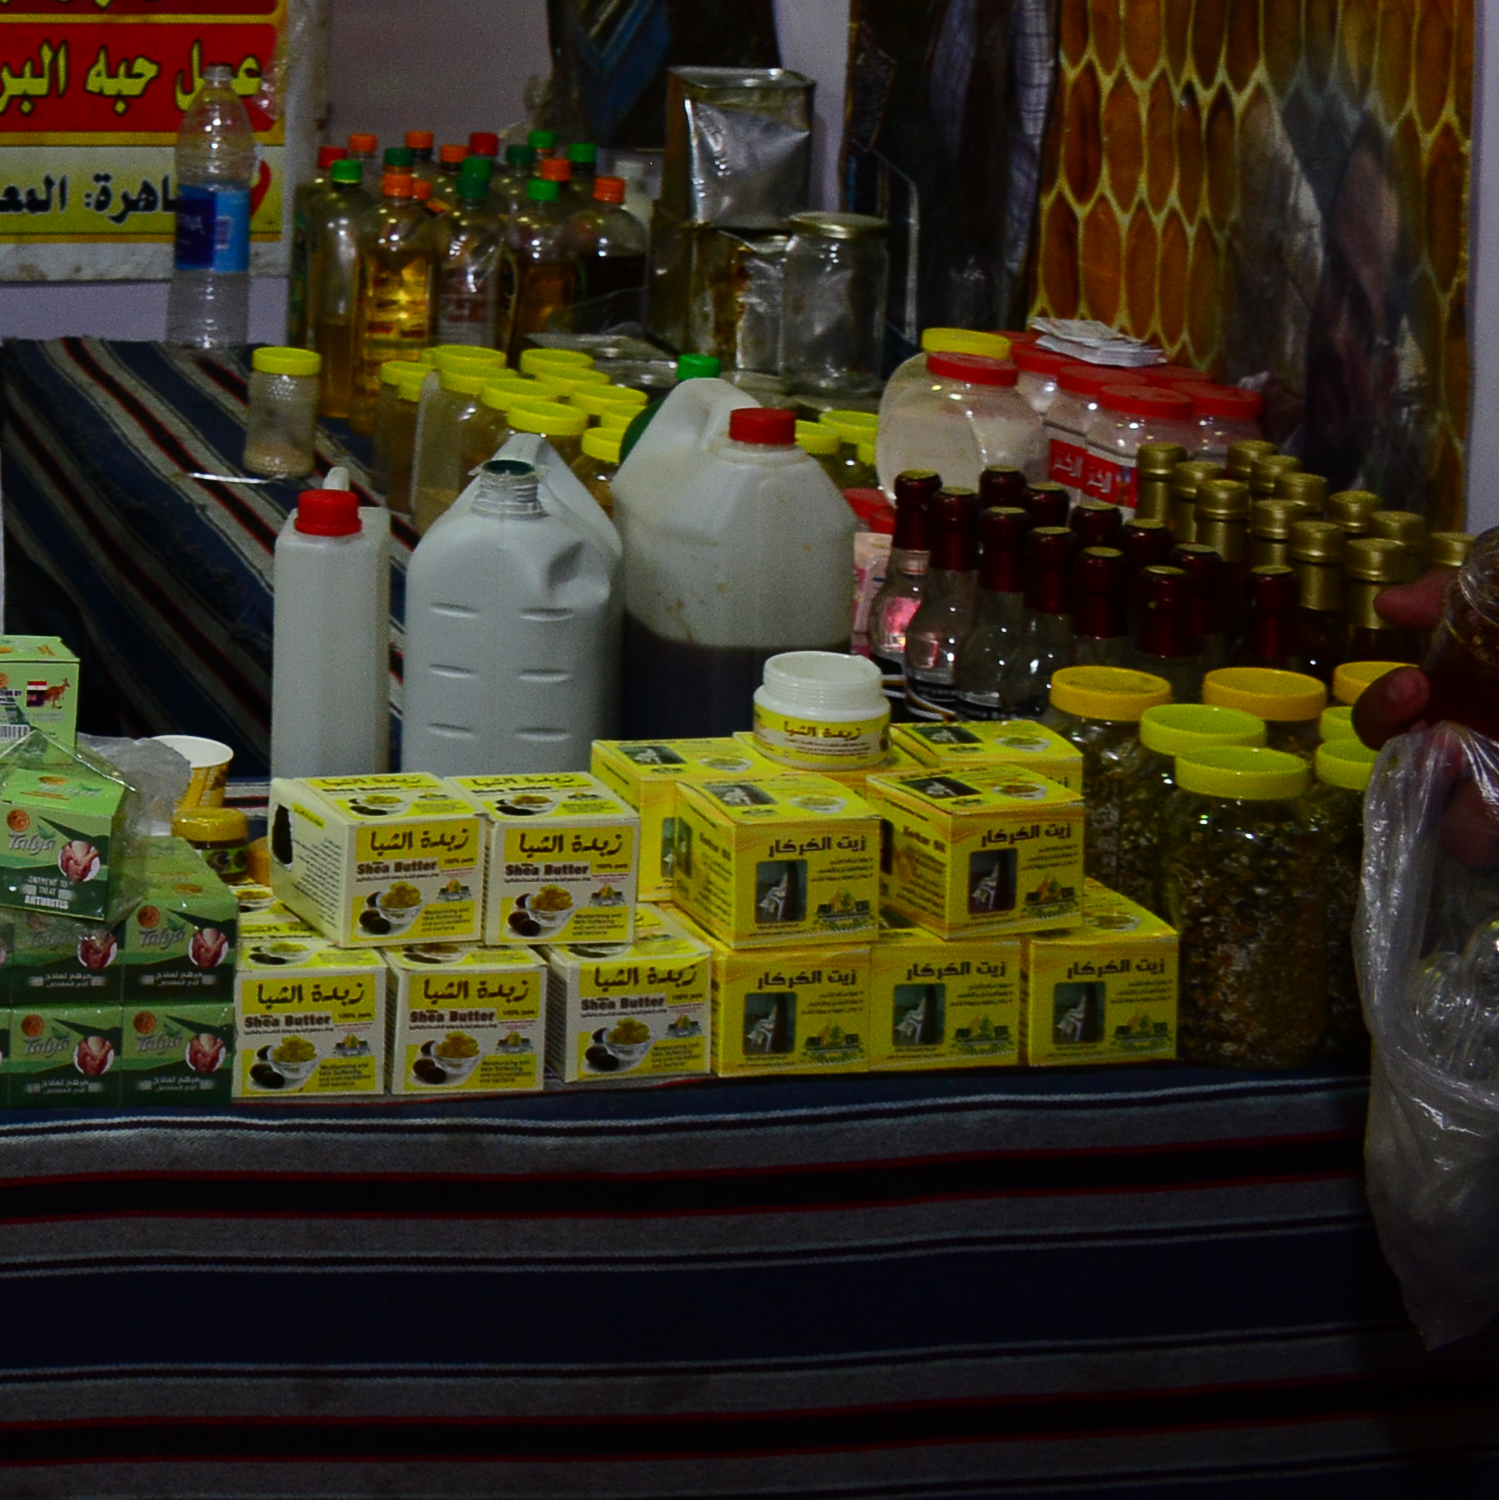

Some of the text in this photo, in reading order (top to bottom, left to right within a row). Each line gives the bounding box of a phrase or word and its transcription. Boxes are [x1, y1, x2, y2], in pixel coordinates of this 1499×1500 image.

[1045, 823, 1071, 838] زيت
[8, 832, 55, 855] Talya
[370, 828, 469, 856] زبدة الشيا
[519, 833, 623, 858] زبدة الشيا
[837, 836, 866, 852] زيت
[394, 860, 437, 873] Butter
[544, 865, 589, 875] Butter
[139, 929, 185, 949] Talya
[975, 961, 1007, 977] زيت
[1136, 959, 1166, 976] زيت
[594, 965, 697, 992] زبدة الشيا
[827, 969, 858, 986] زيت
[257, 982, 365, 1009] زبدة الشيا
[424, 979, 529, 1005] زبدة الشيا
[620, 997, 665, 1009] Butter
[284, 1012, 331, 1026] Butter
[449, 1009, 495, 1022] Butter
[24, 1037, 71, 1058] Talya
[137, 1033, 182, 1055] Talya
